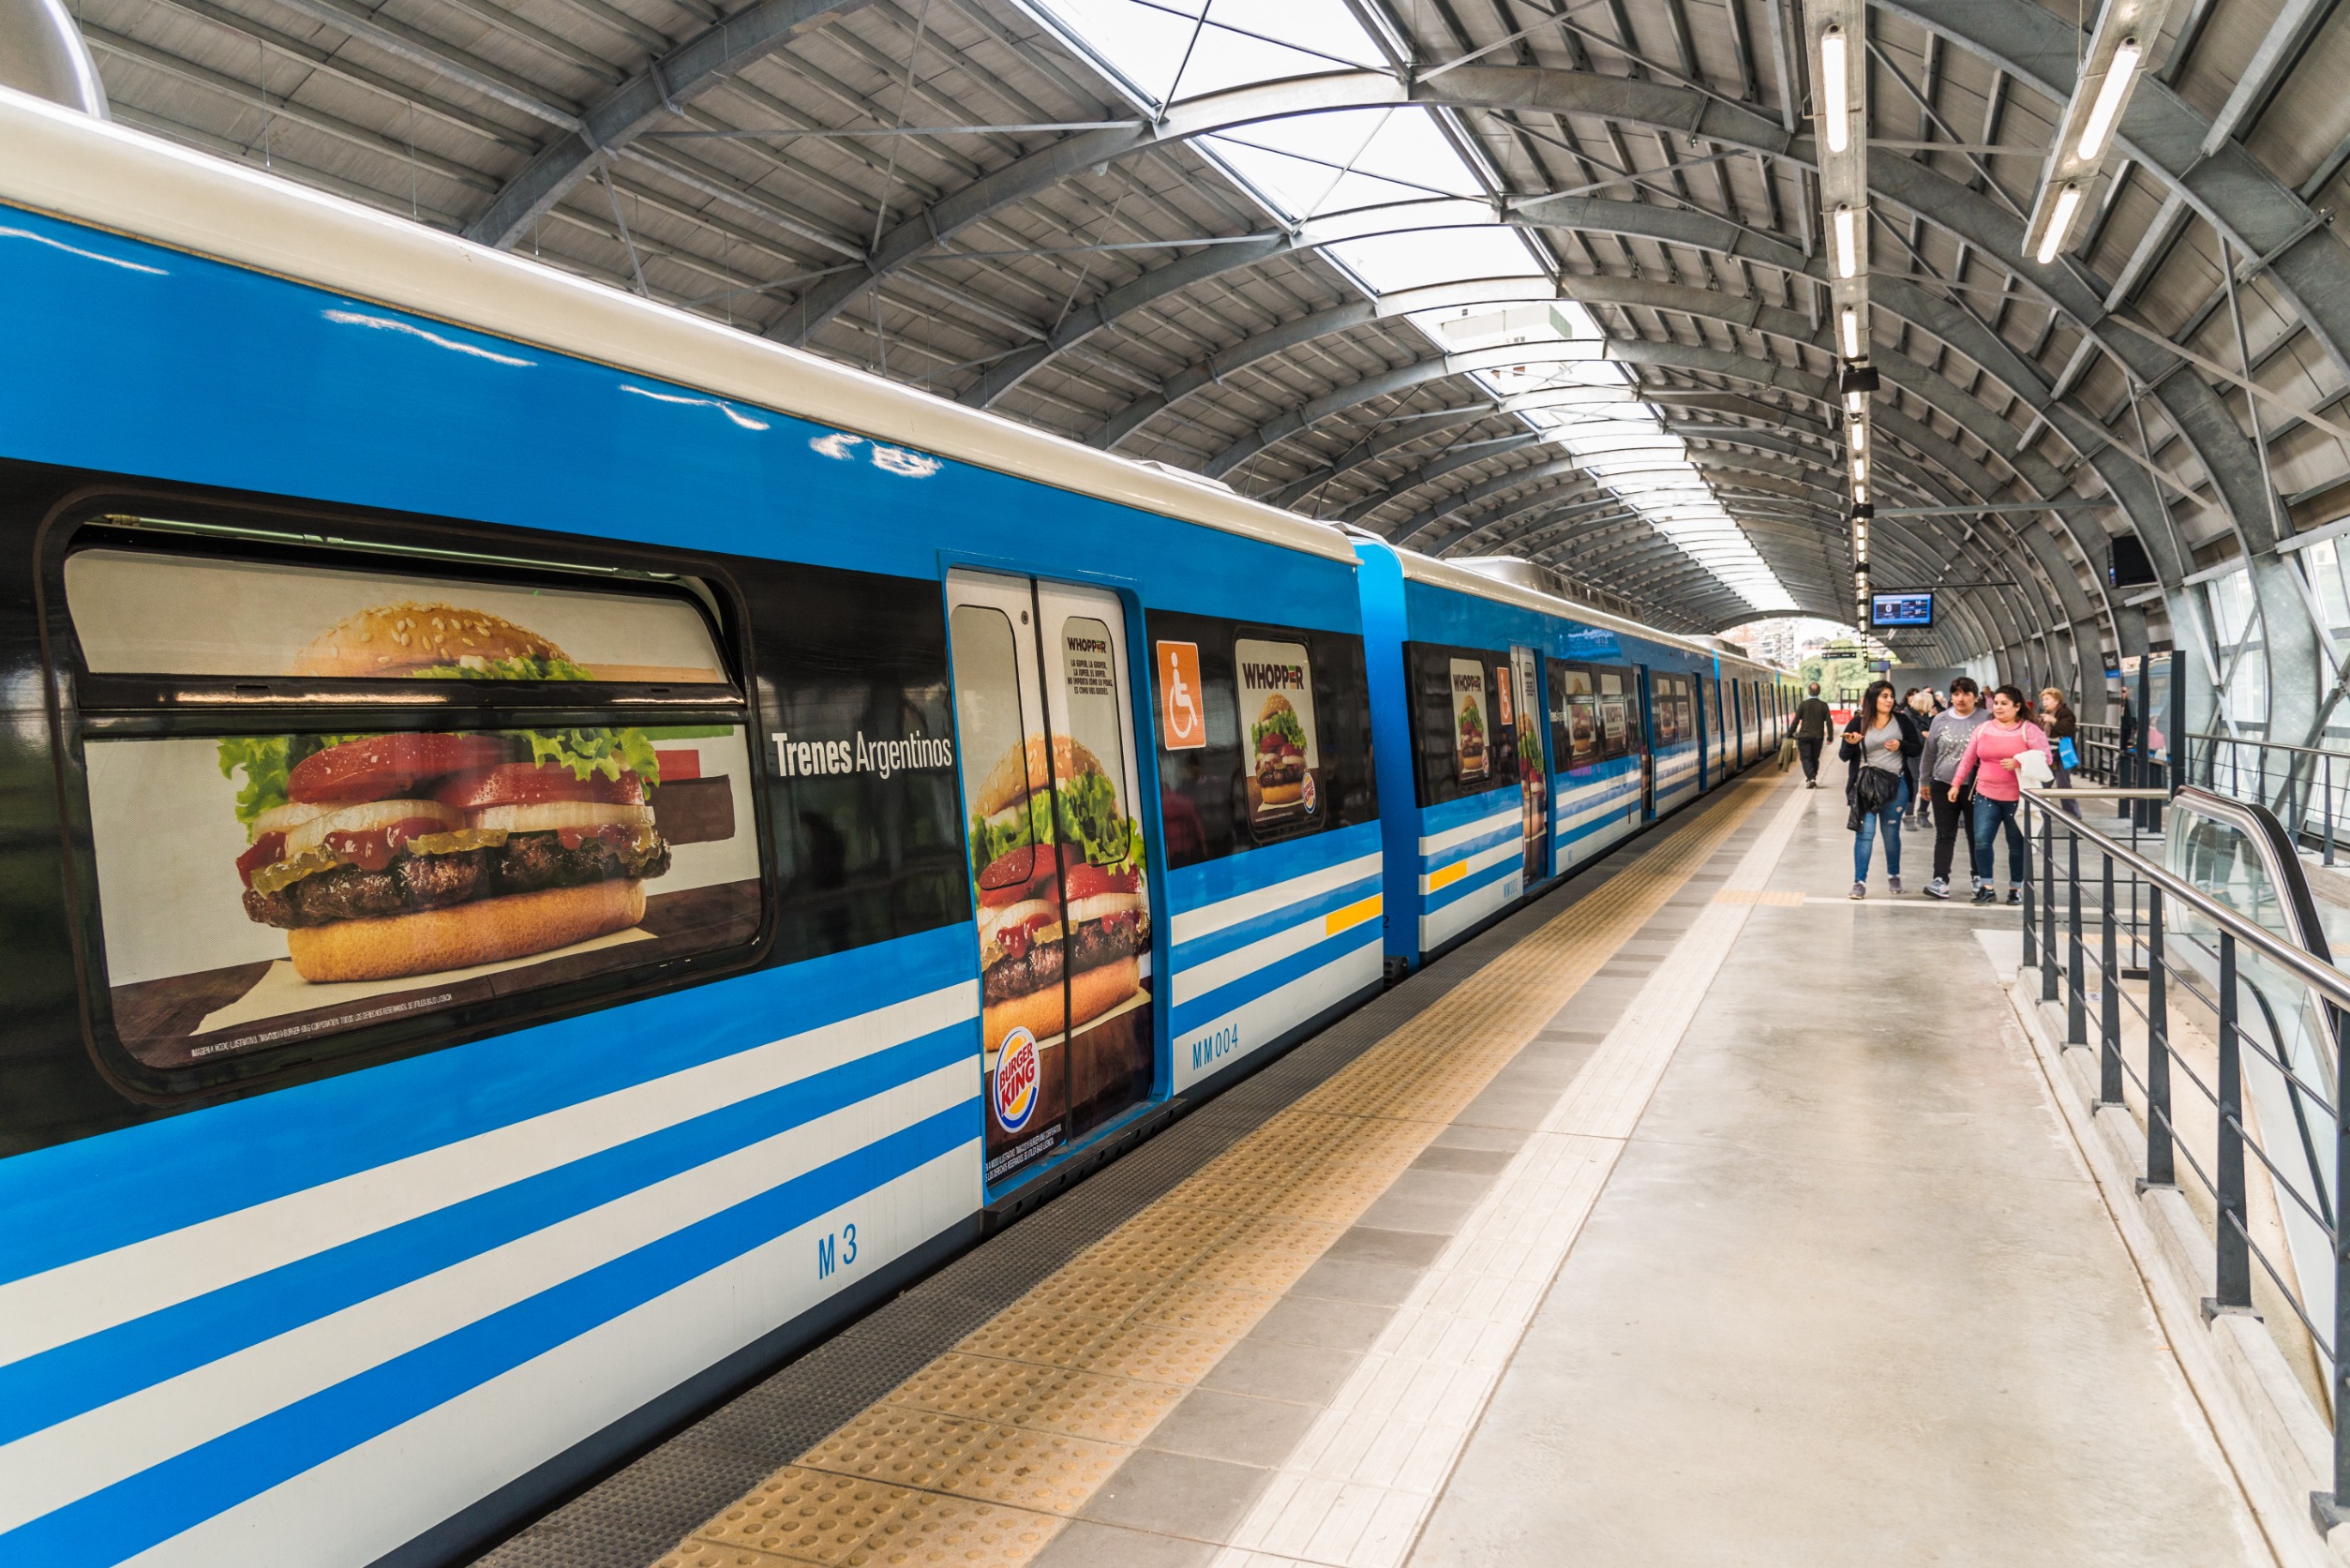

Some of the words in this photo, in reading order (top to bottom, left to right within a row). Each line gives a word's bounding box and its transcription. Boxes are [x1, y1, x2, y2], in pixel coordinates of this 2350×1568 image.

[1067, 637, 1106, 653] WHOPPER
[1242, 663, 1304, 690] WHOPPER
[1453, 674, 1482, 692] WHOPPER
[771, 732, 853, 777] Trenes
[856, 730, 952, 780] Argentinos
[999, 1042, 1033, 1091] BURGER
[1193, 1023, 1237, 1070] MM004
[1001, 1057, 1035, 1114] KING
